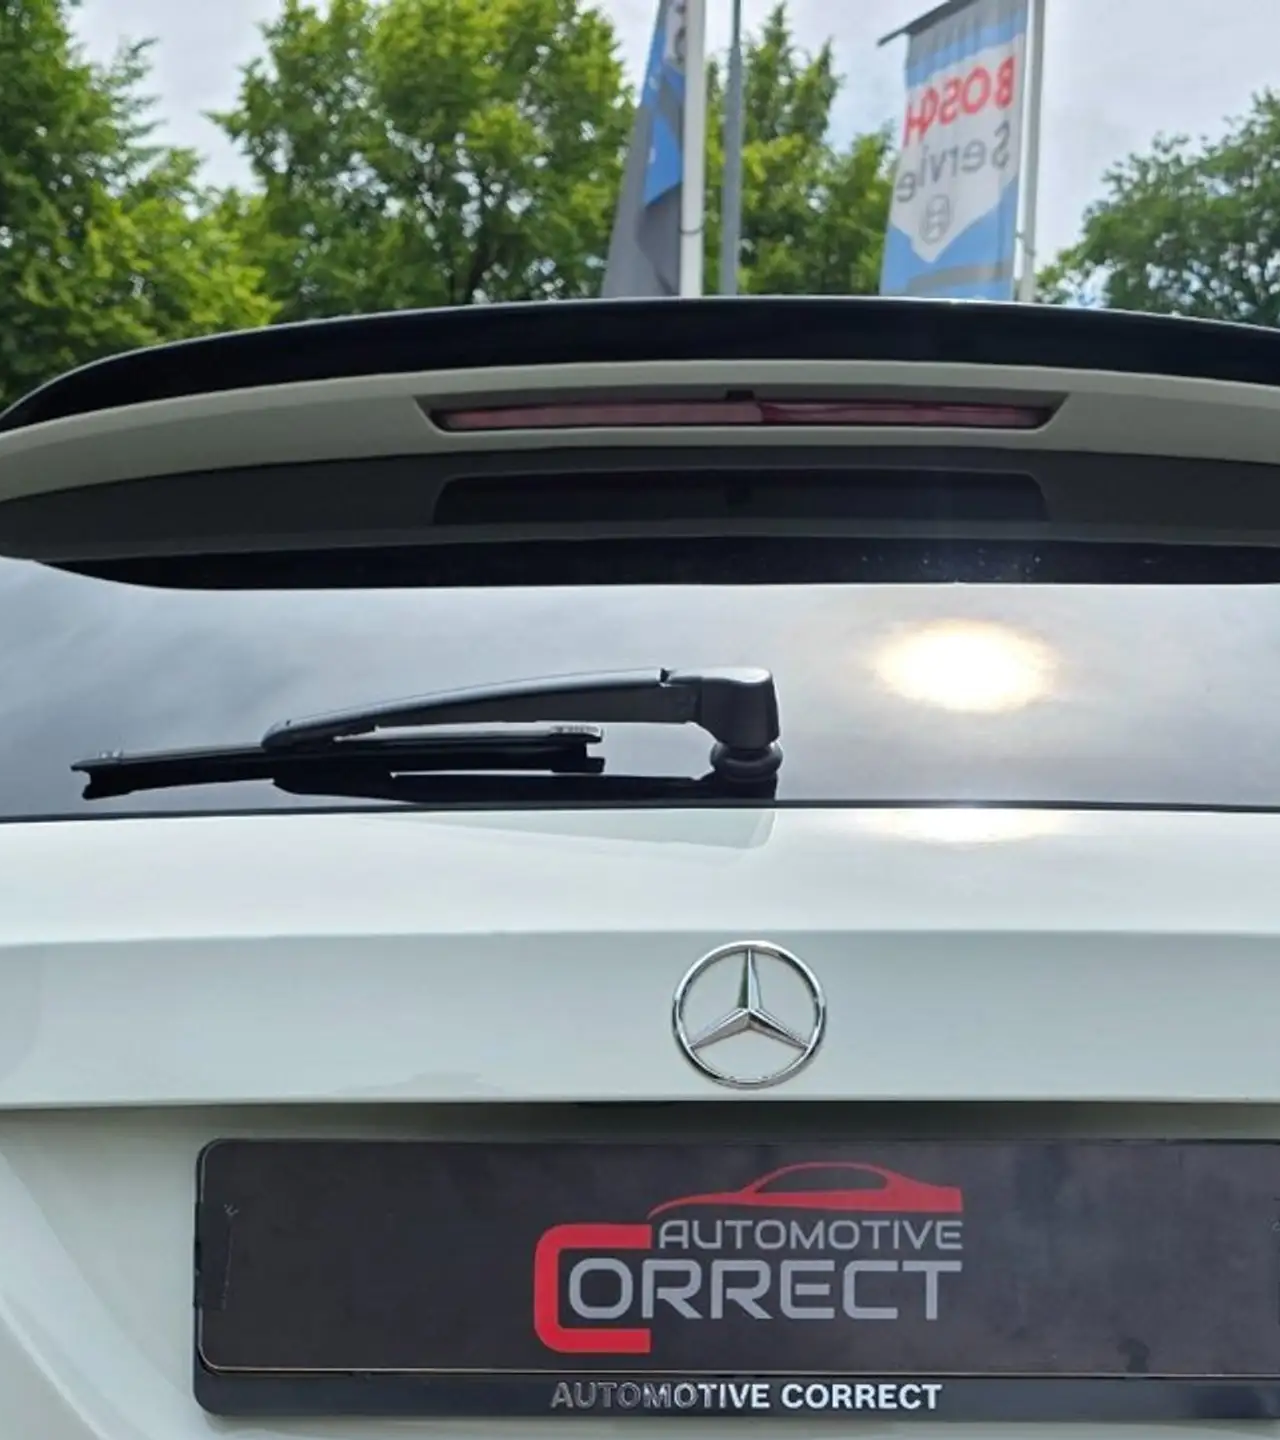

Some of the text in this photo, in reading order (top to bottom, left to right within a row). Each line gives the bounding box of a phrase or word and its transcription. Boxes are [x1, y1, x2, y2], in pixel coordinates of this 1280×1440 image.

[658, 1219, 964, 1251] AUTOMOTIVE
[533, 1223, 963, 1354] CORRECT
[551, 1381, 943, 1410] AUTOMOTIVE CORRECT
